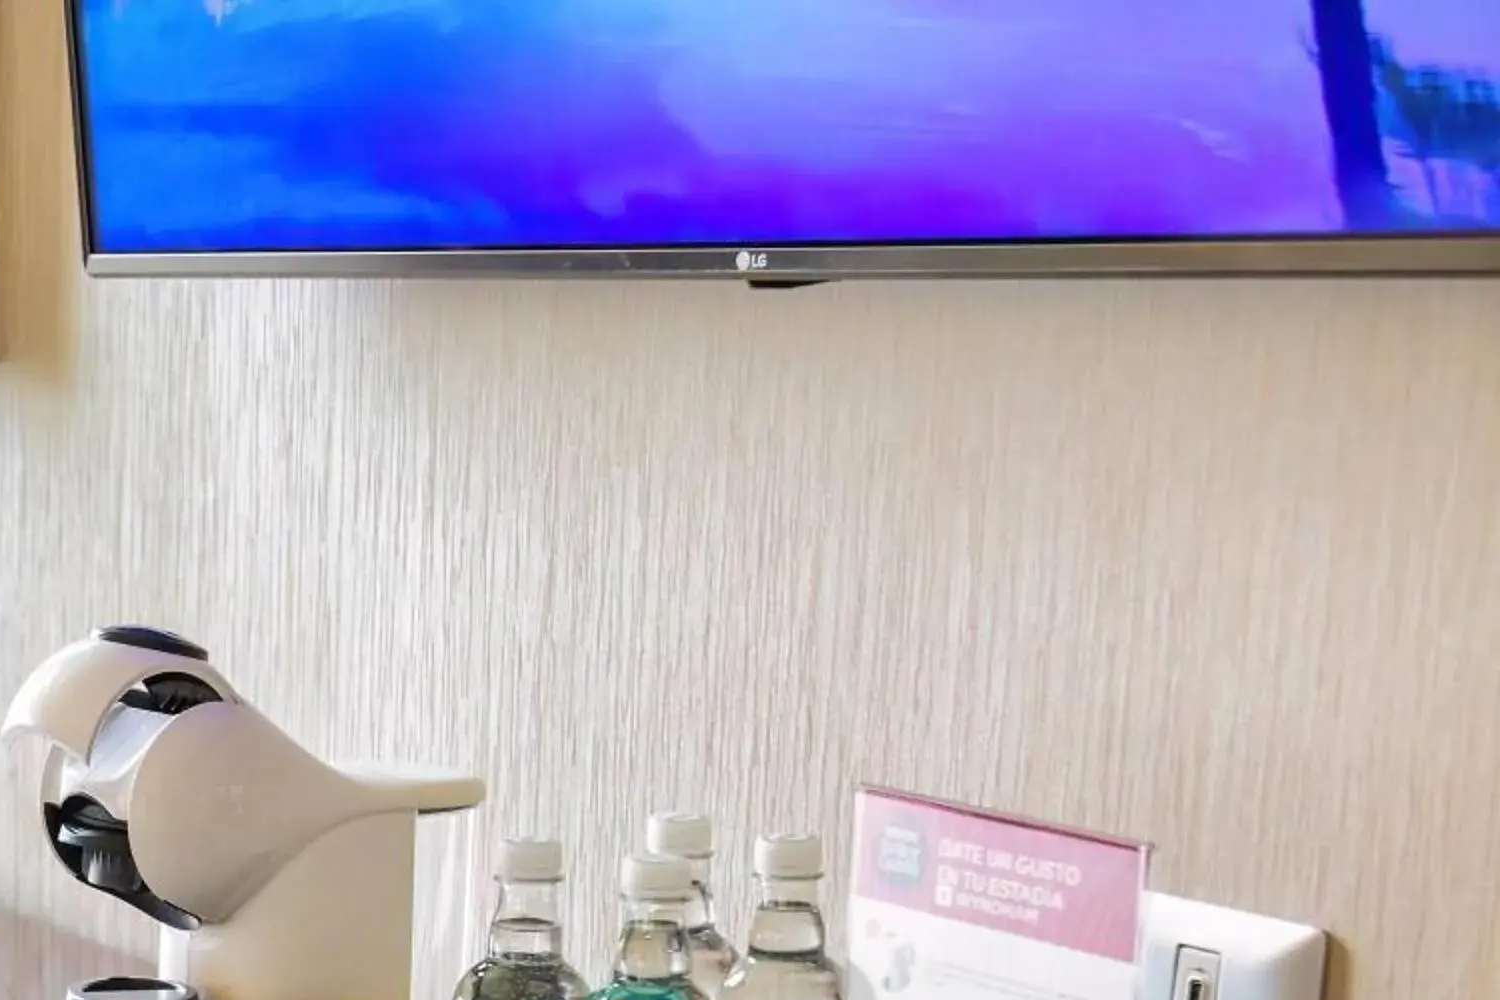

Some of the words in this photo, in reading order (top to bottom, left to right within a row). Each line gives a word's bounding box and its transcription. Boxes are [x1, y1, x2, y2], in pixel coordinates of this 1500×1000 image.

[751, 253, 767, 268] LG
[938, 838, 985, 865] DATE
[985, 848, 1013, 871] UN
[1014, 854, 1083, 887] GUSTO
[937, 864, 958, 886] EN
[963, 870, 986, 892] TU
